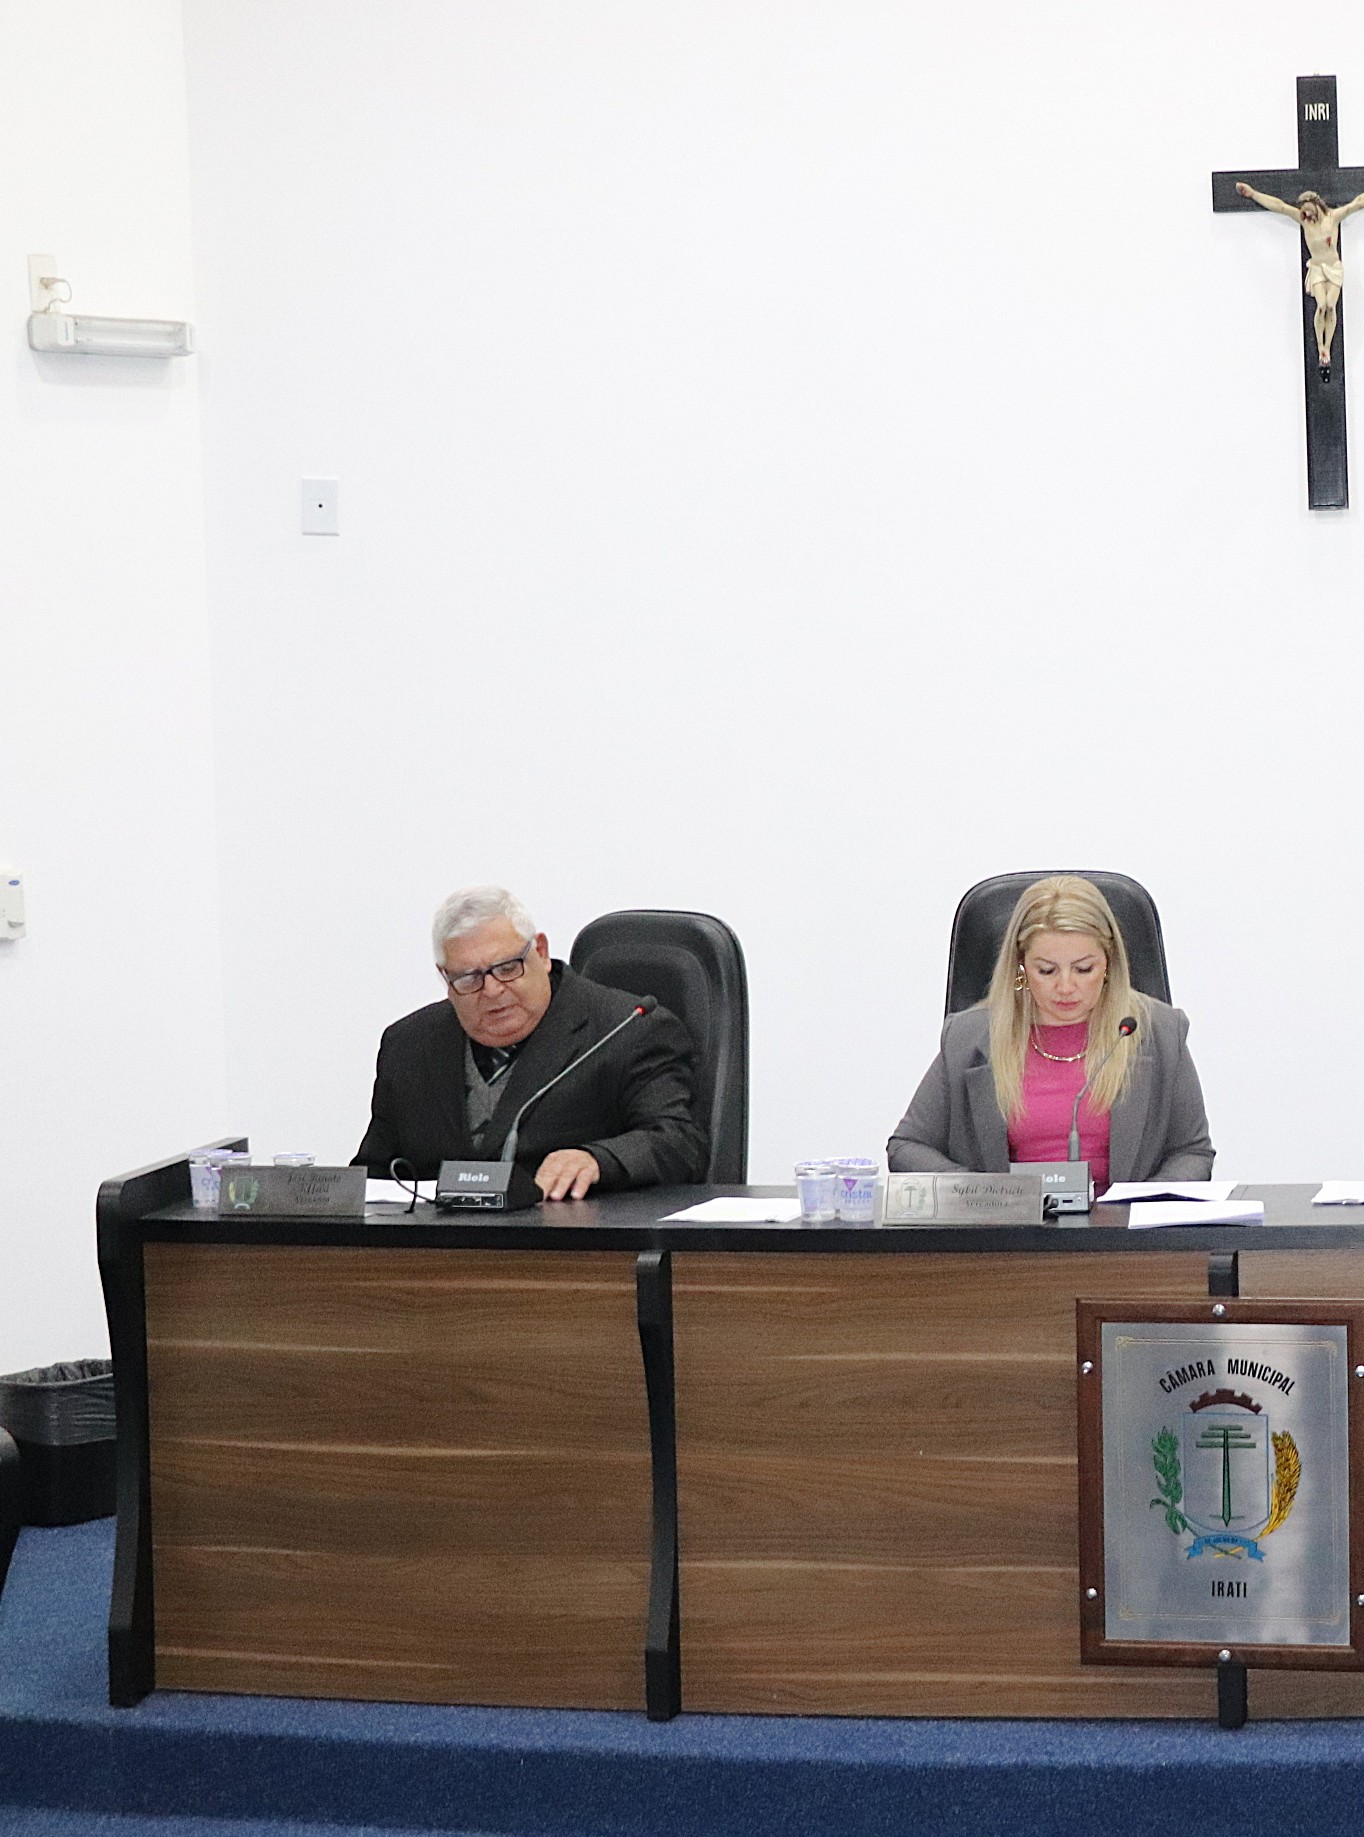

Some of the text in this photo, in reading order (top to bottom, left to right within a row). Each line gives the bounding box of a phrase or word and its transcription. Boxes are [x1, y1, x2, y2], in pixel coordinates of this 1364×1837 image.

[1305, 103, 1330, 121] INRI
[1159, 1358, 1296, 1396] CÂMARA MUNICIPAL
[1211, 1580, 1248, 1598] IRATI
